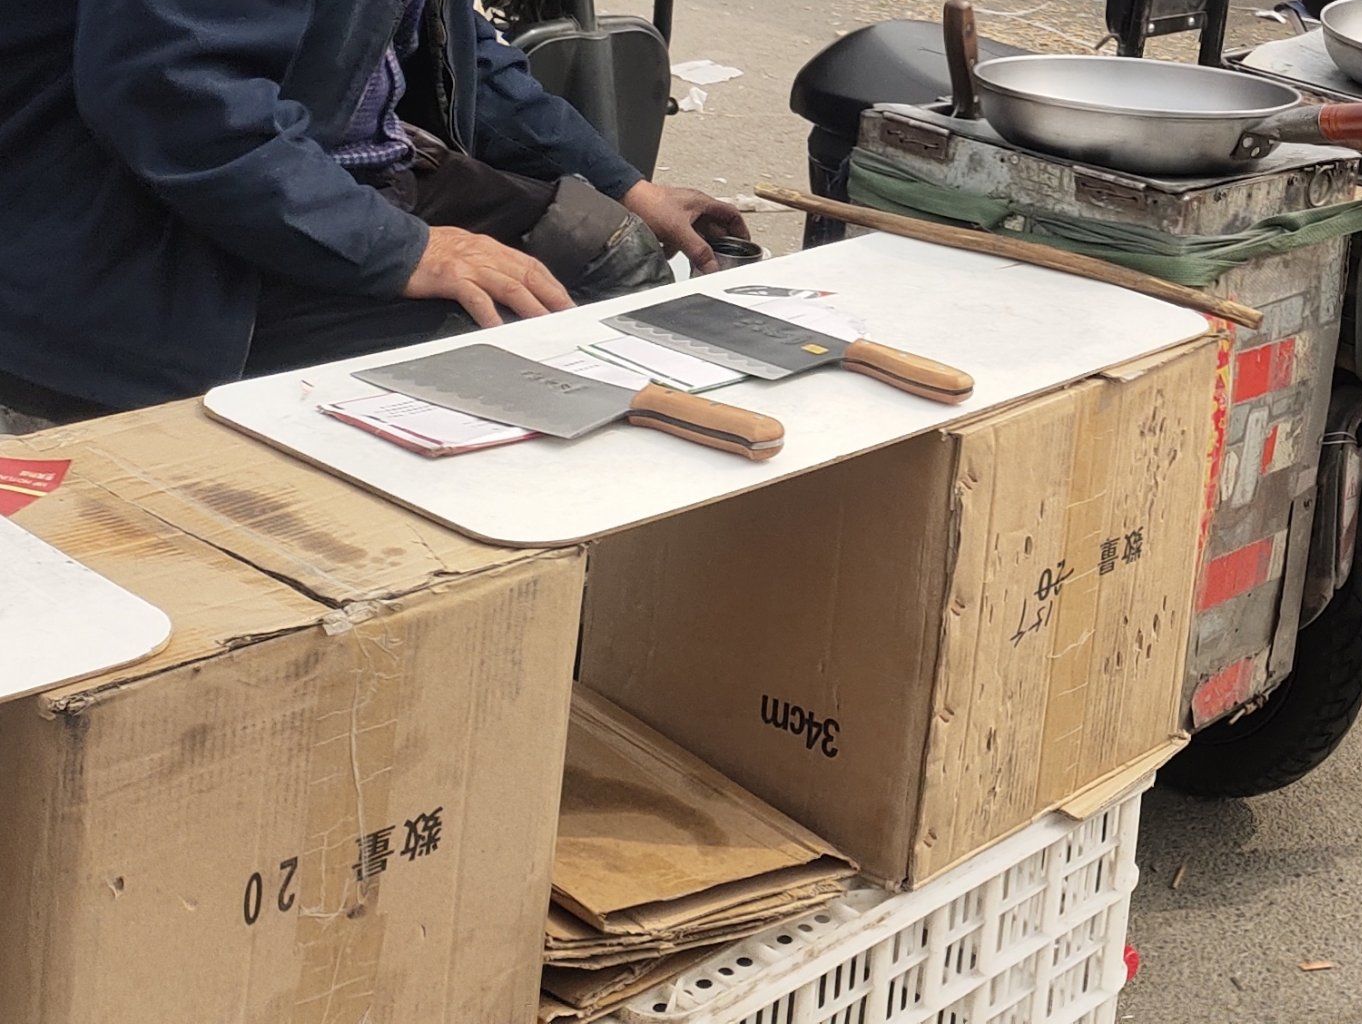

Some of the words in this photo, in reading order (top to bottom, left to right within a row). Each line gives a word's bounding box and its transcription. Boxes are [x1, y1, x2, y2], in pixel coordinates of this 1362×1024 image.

[1098, 526, 1144, 576] 数量
[761, 694, 840, 758] 34cm
[352, 806, 443, 881] 数量
[244, 856, 298, 926] 20
